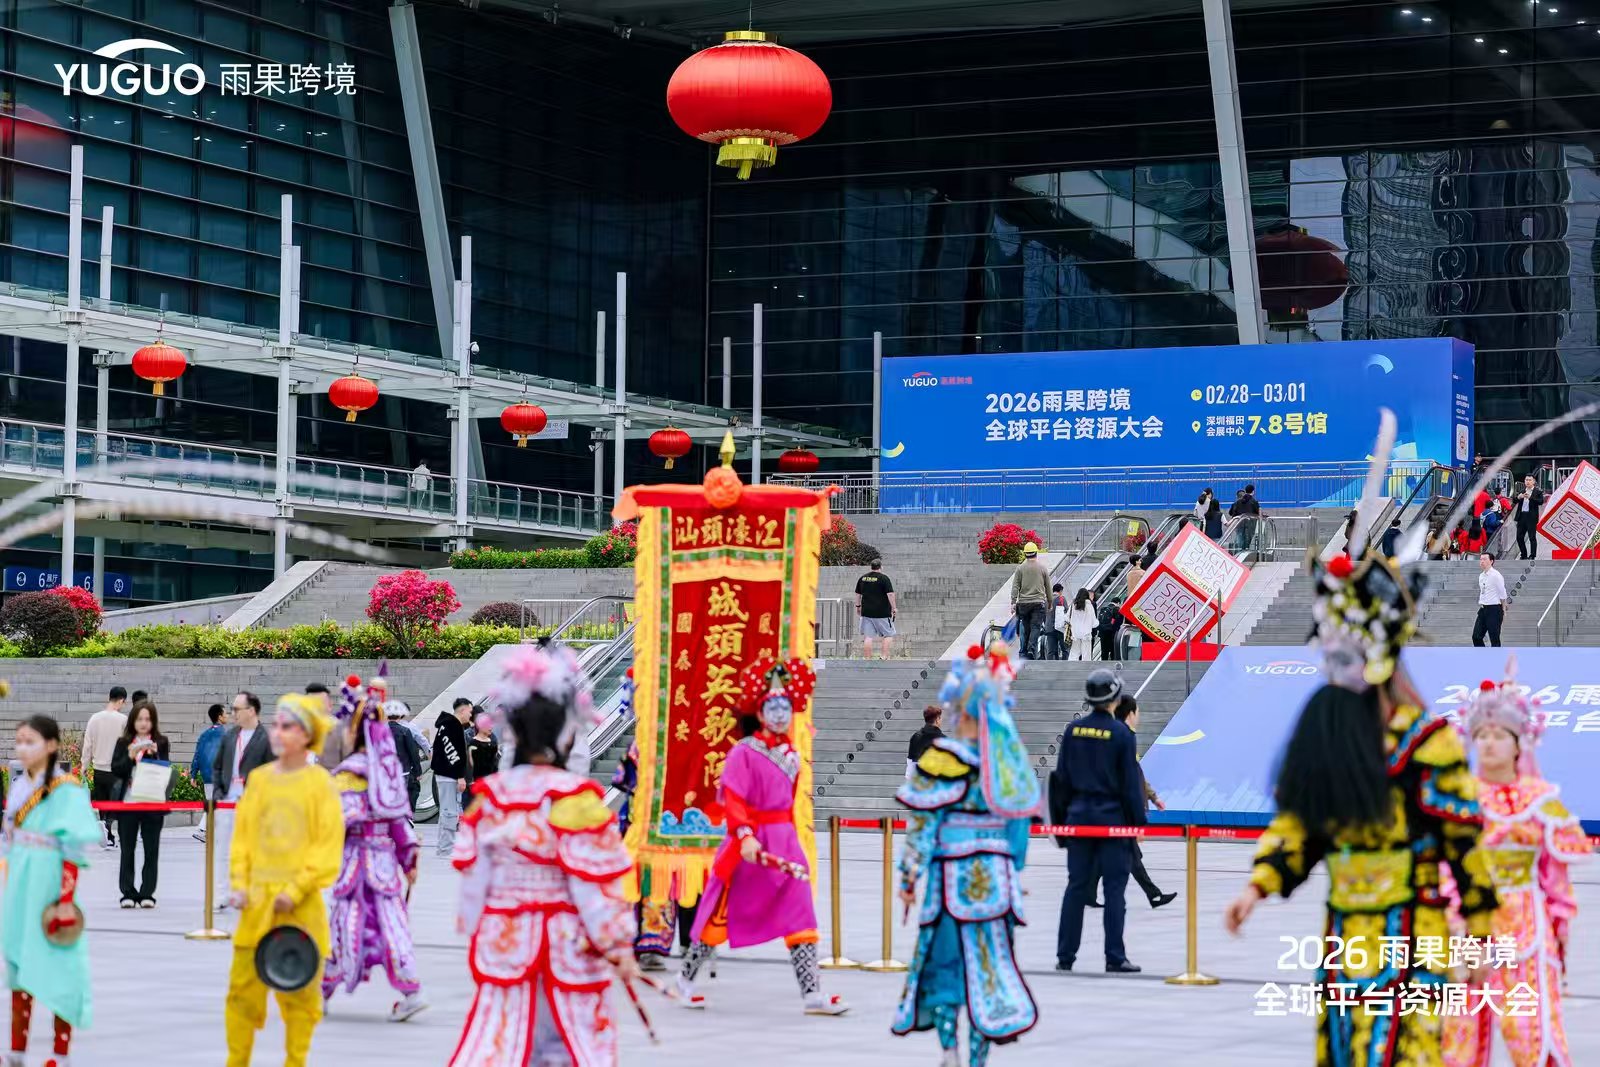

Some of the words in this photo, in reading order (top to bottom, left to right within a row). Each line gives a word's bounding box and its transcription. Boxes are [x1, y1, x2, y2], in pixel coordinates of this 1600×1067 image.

[902, 377, 938, 388] YUGUO
[985, 387, 1131, 414] 2026雨果跨境
[985, 415, 1164, 441] 全球平台资源大会
[1206, 415, 1245, 426] 深圳福田
[1206, 426, 1245, 437] 会展中心
[675, 514, 782, 546] 汕頭濠江
[1550, 505, 1579, 534] SIGN
[1196, 540, 1234, 575] SIGN
[1153, 594, 1192, 628] CHINA
[1160, 582, 1198, 619] SIGN
[1137, 614, 1155, 631] Since
[1143, 603, 1183, 638] 2026
[1244, 665, 1318, 675] YUGUO
